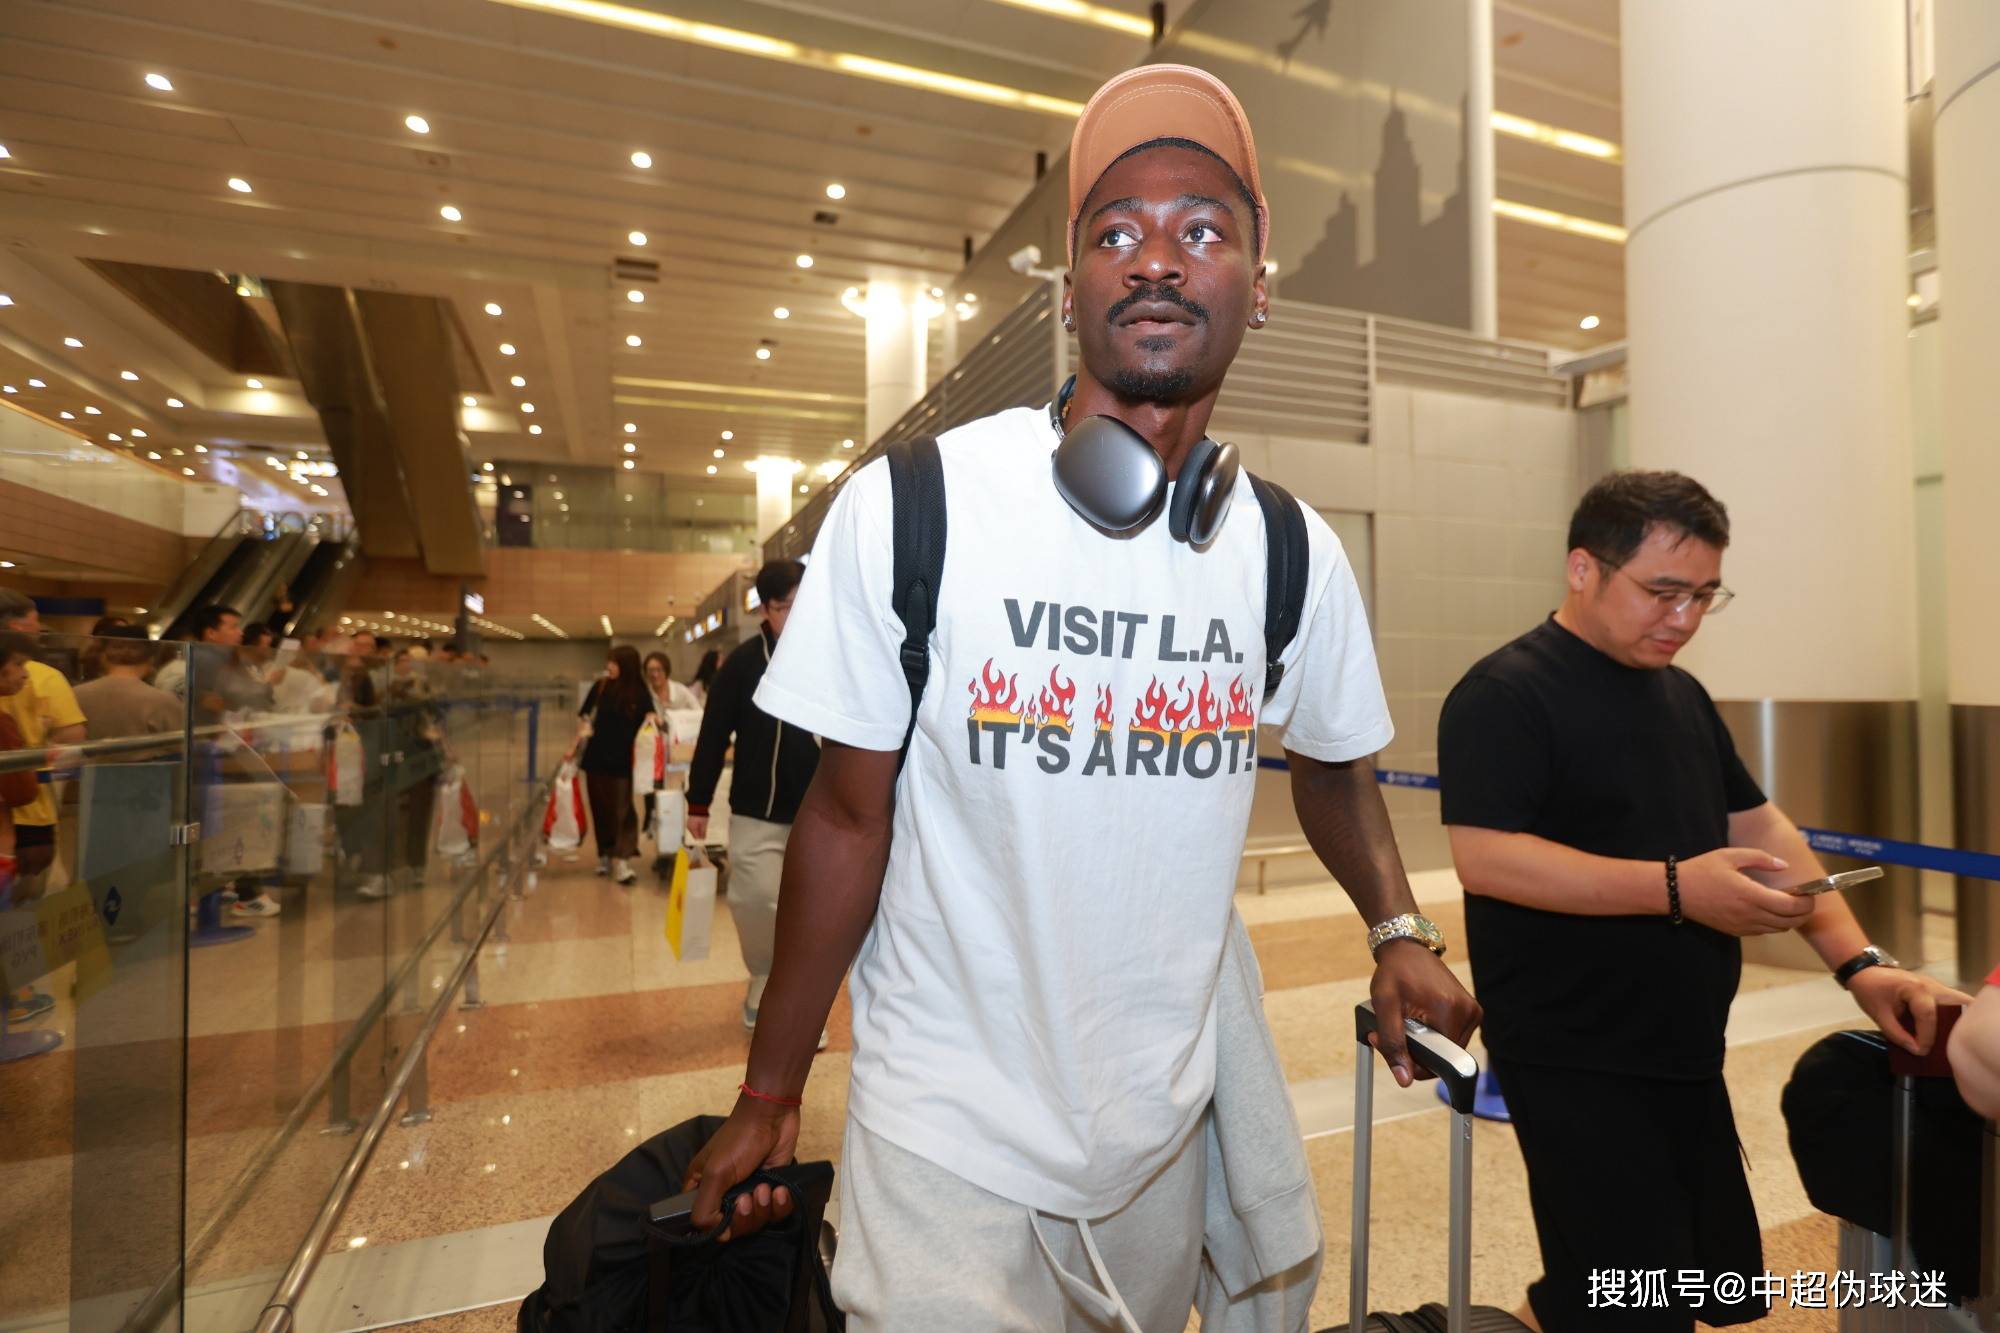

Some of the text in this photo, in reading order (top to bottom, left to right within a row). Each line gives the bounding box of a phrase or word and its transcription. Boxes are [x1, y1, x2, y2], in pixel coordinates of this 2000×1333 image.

[1003, 598, 1244, 664] VISIT L.A.
[967, 717, 1256, 779] IT'S A RIOT!
